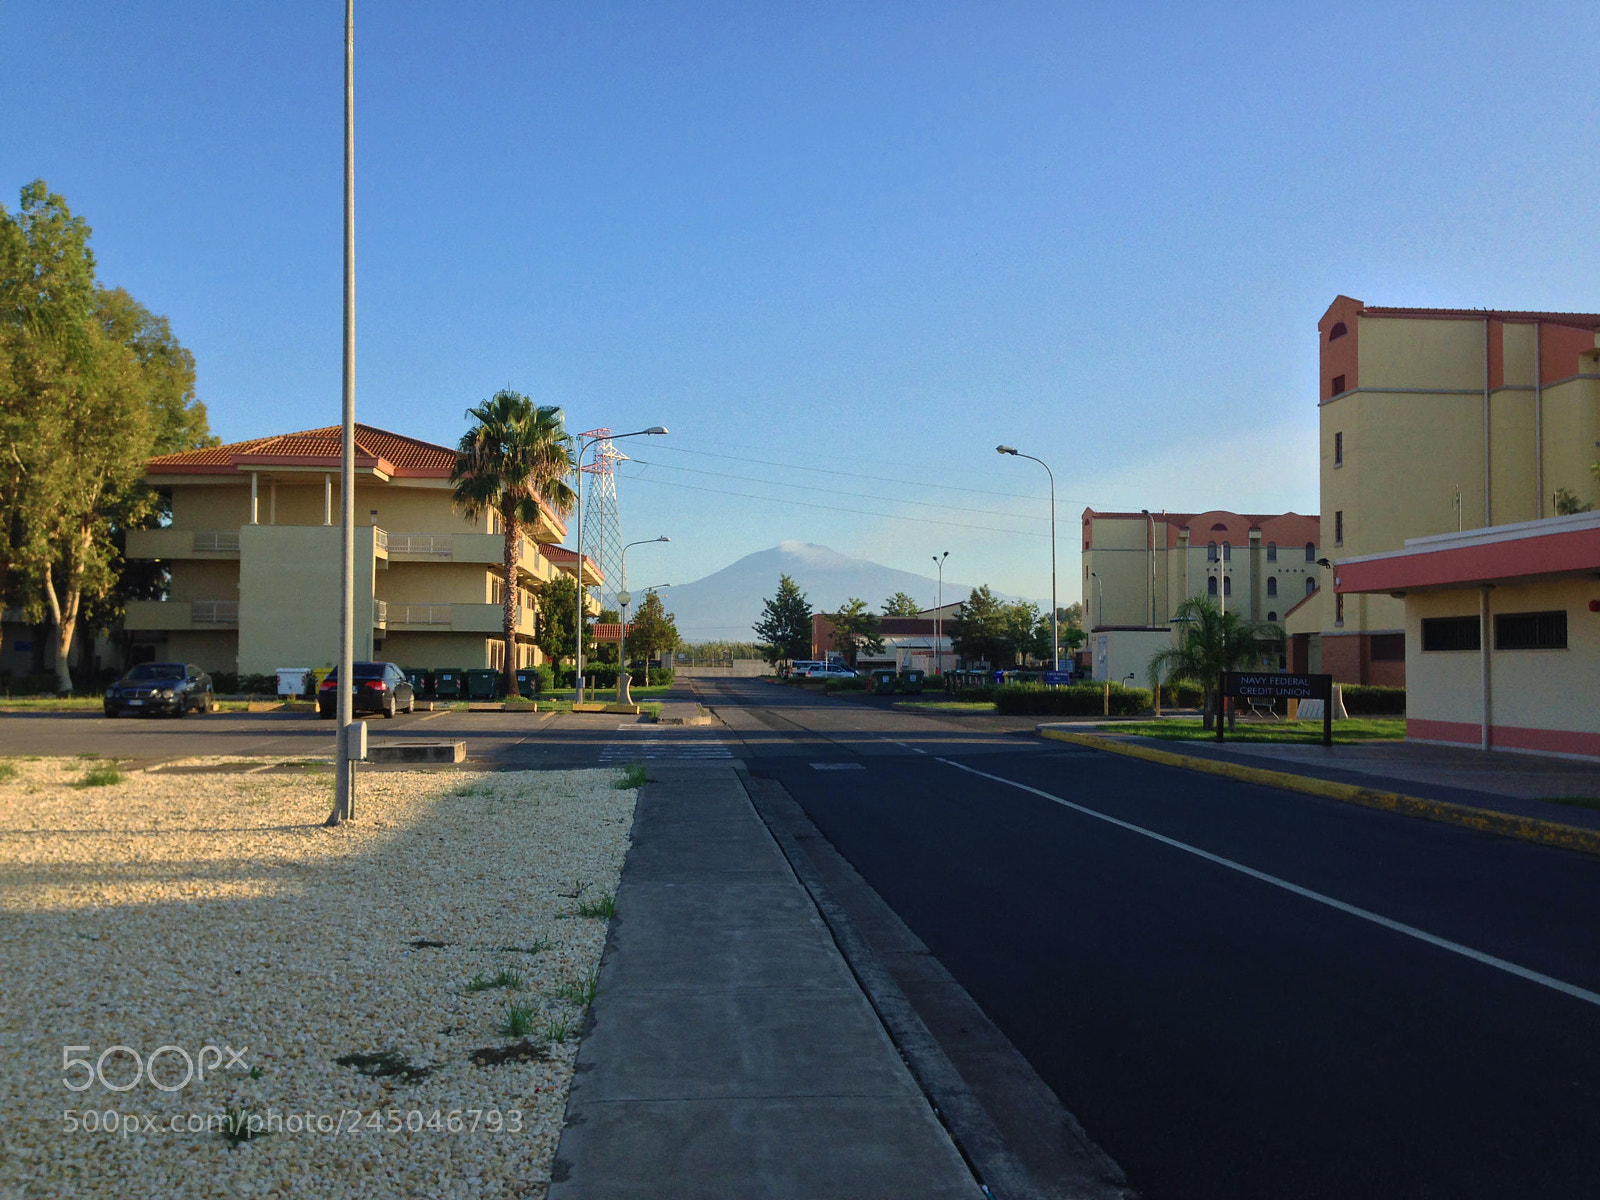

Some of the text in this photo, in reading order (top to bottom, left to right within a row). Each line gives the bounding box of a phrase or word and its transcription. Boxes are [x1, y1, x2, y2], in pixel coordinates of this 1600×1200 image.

[1241, 676, 1309, 686] NAVY FEDERAL
[1240, 686, 1311, 696] CREDIT UNION
